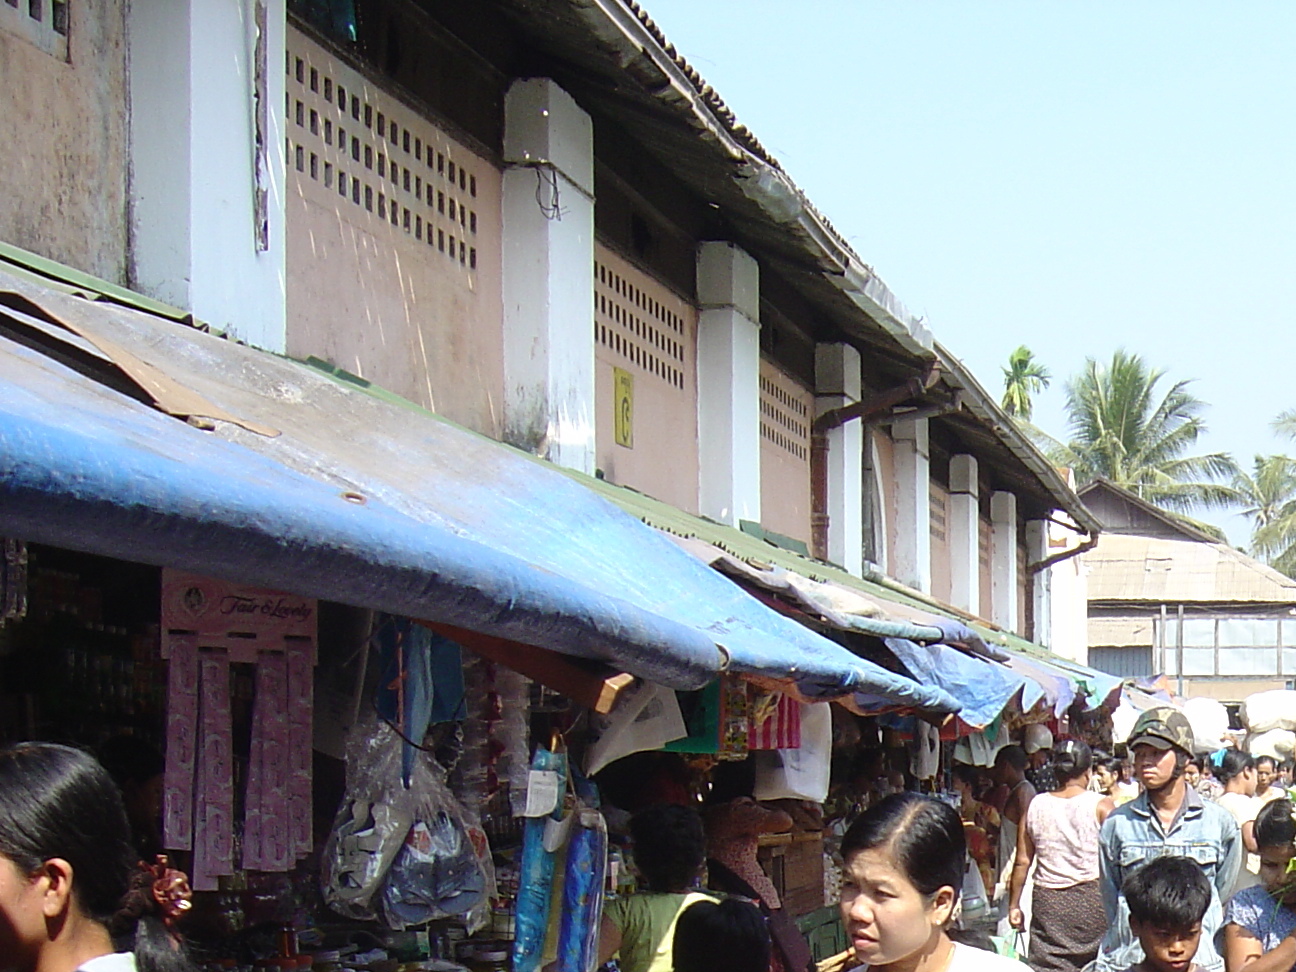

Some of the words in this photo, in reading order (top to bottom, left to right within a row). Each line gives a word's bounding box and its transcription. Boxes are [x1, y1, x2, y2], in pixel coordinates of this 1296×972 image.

[220, 595, 259, 615] Fair
[260, 598, 272, 615] &
[271, 598, 312, 622] Lovely
